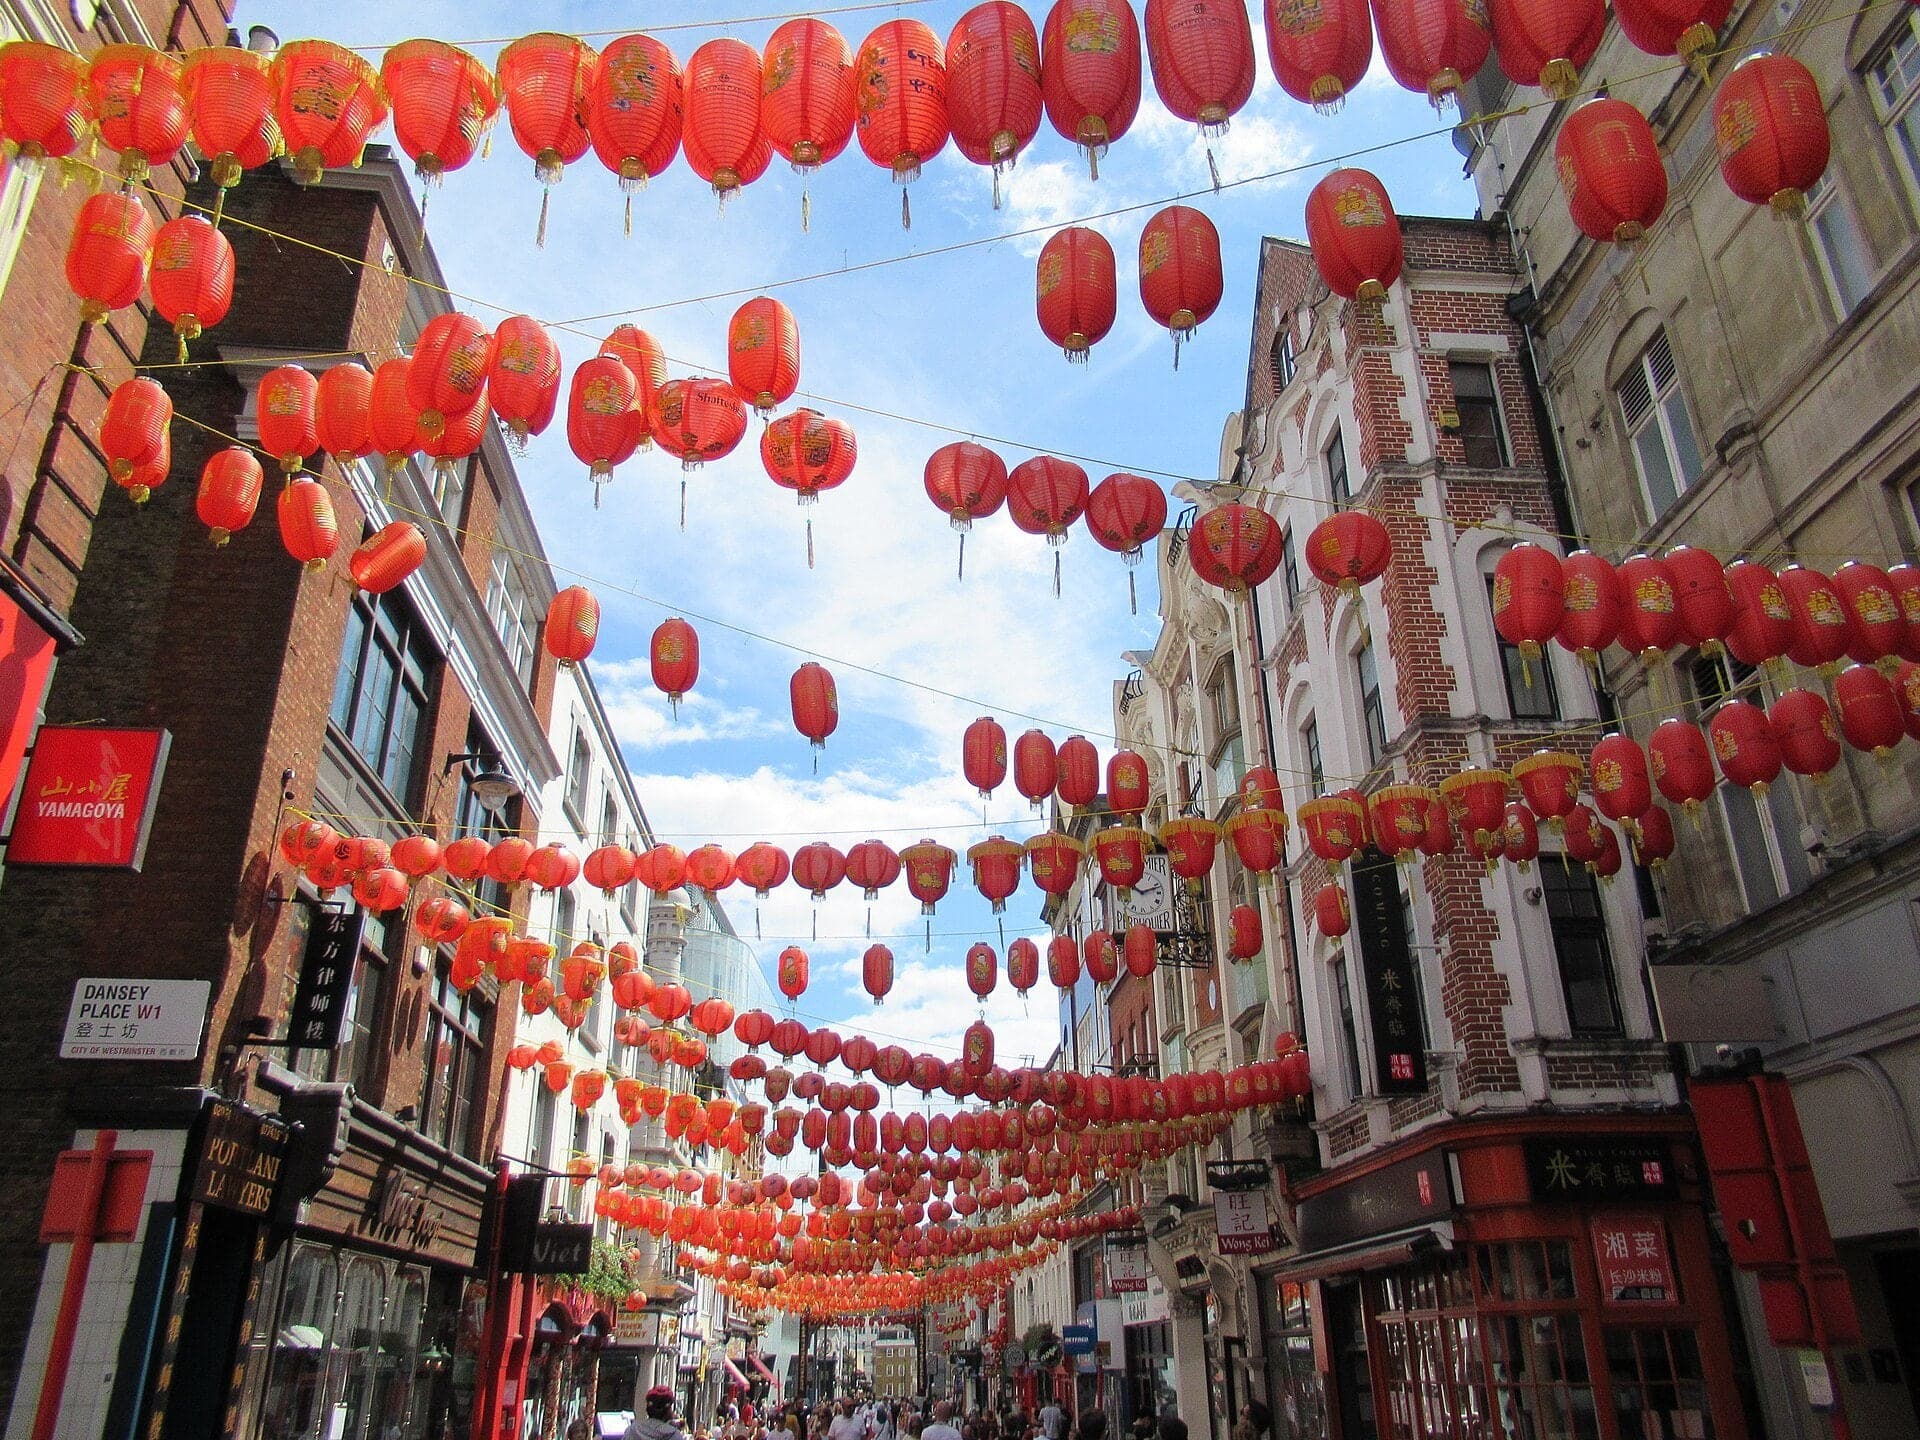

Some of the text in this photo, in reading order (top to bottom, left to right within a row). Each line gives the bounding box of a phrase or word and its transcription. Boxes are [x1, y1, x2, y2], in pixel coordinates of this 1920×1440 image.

[38, 801, 125, 819] YAMAGOYA
[304, 914, 346, 1042] 东方律师楼
[84, 985, 150, 1000] DANSEY
[80, 1003, 162, 1020] PLACE W1
[75, 1022, 139, 1039] 登士坊
[71, 1046, 87, 1055] CITY
[89, 1046, 101, 1055] OF
[102, 1047, 156, 1056] WESTMINSTER
[207, 1168, 273, 1213] LAYERS
[1228, 1193, 1255, 1232] 旺記
[533, 1238, 581, 1263] Viet
[1221, 1235, 1271, 1252] Wong Kei
[1601, 1231, 1659, 1259] 湘菜
[1113, 1279, 1146, 1291] Wong Kei
[1609, 1268, 1662, 1285] 长沙米粉
